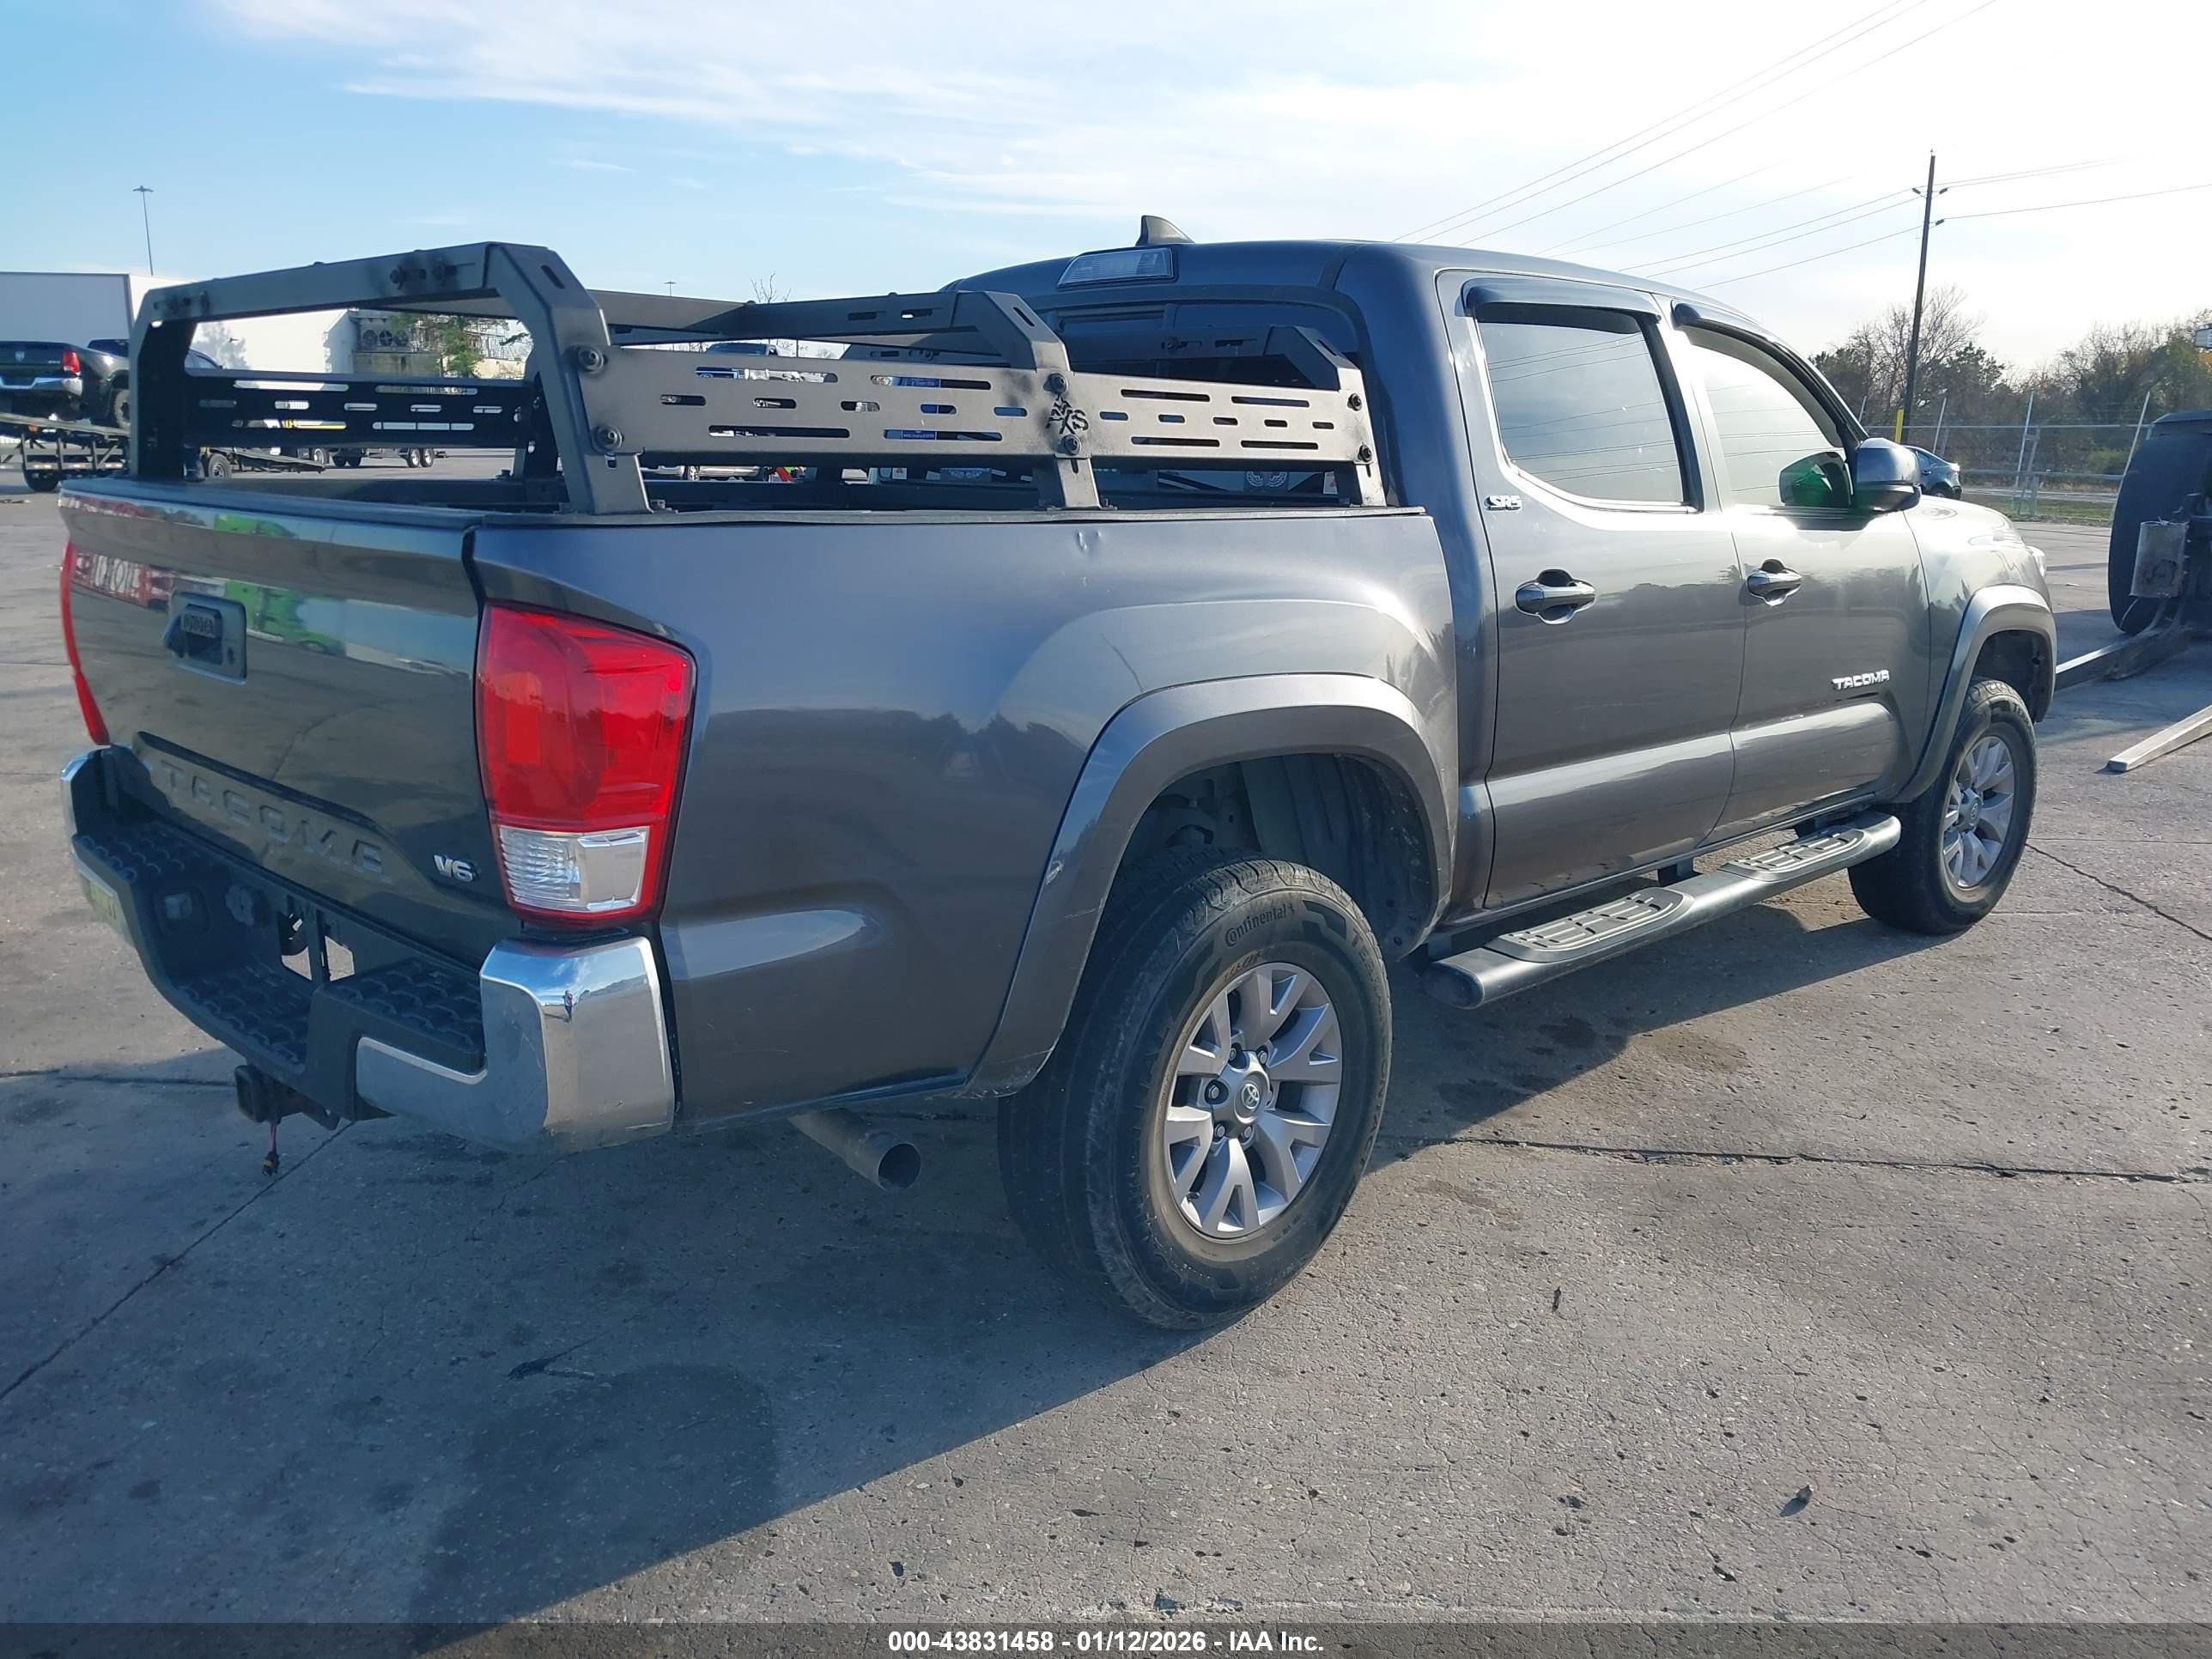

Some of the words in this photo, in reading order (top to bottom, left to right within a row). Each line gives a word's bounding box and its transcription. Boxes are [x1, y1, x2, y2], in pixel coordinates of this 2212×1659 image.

[1489, 495, 1521, 510] SR5
[1832, 669, 1890, 690] TACOMA
[160, 759, 388, 879] TACOMA
[433, 854, 473, 882] V6
[1224, 902, 1287, 947] Continental
